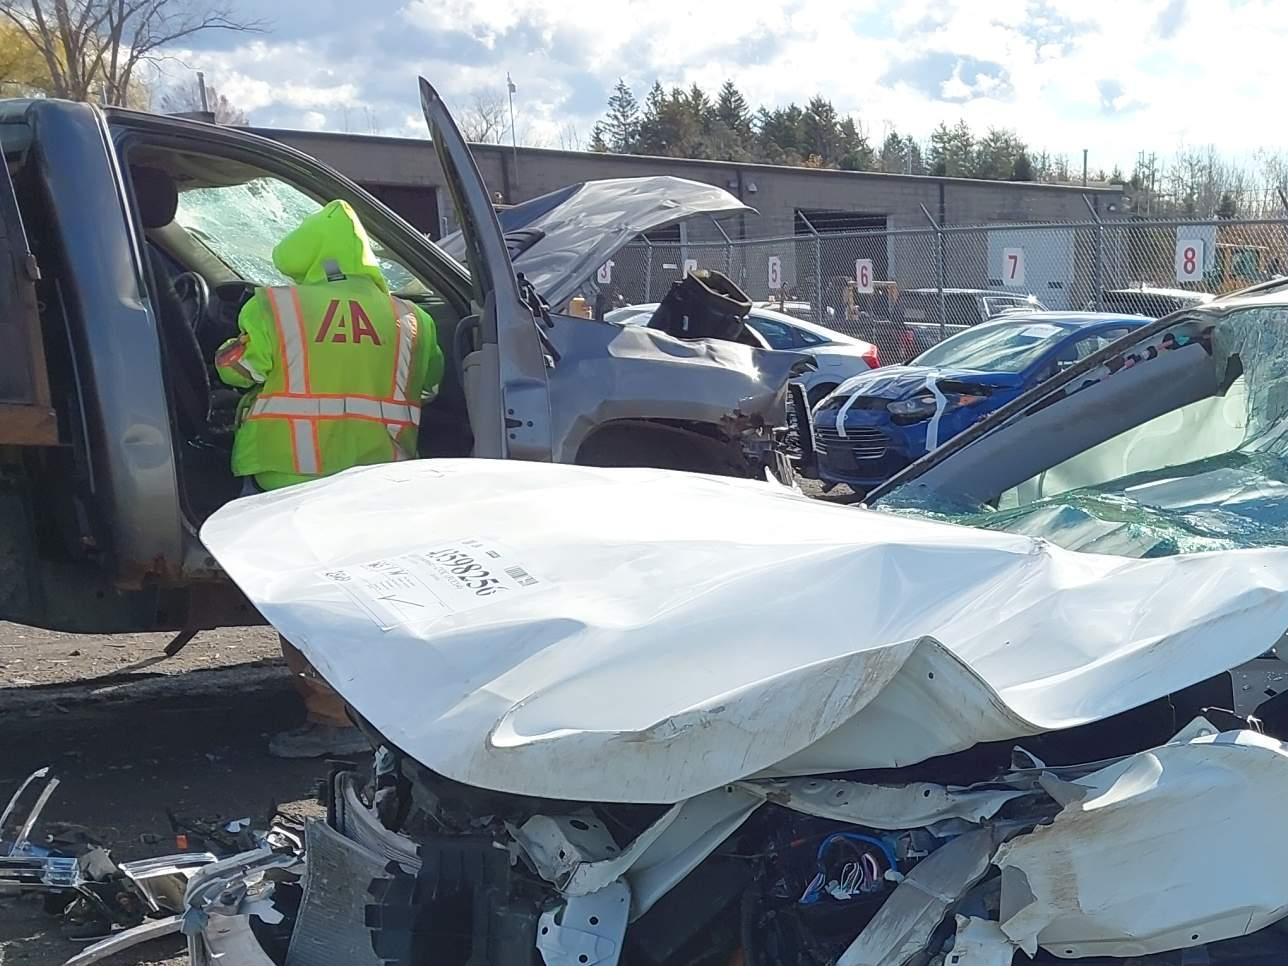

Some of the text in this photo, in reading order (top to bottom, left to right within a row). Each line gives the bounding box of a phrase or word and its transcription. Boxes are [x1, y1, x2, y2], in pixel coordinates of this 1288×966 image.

[771, 262, 778, 283] 5
[1008, 255, 1018, 279] 7
[1183, 247, 1196, 275] 8
[860, 265, 868, 287] 6
